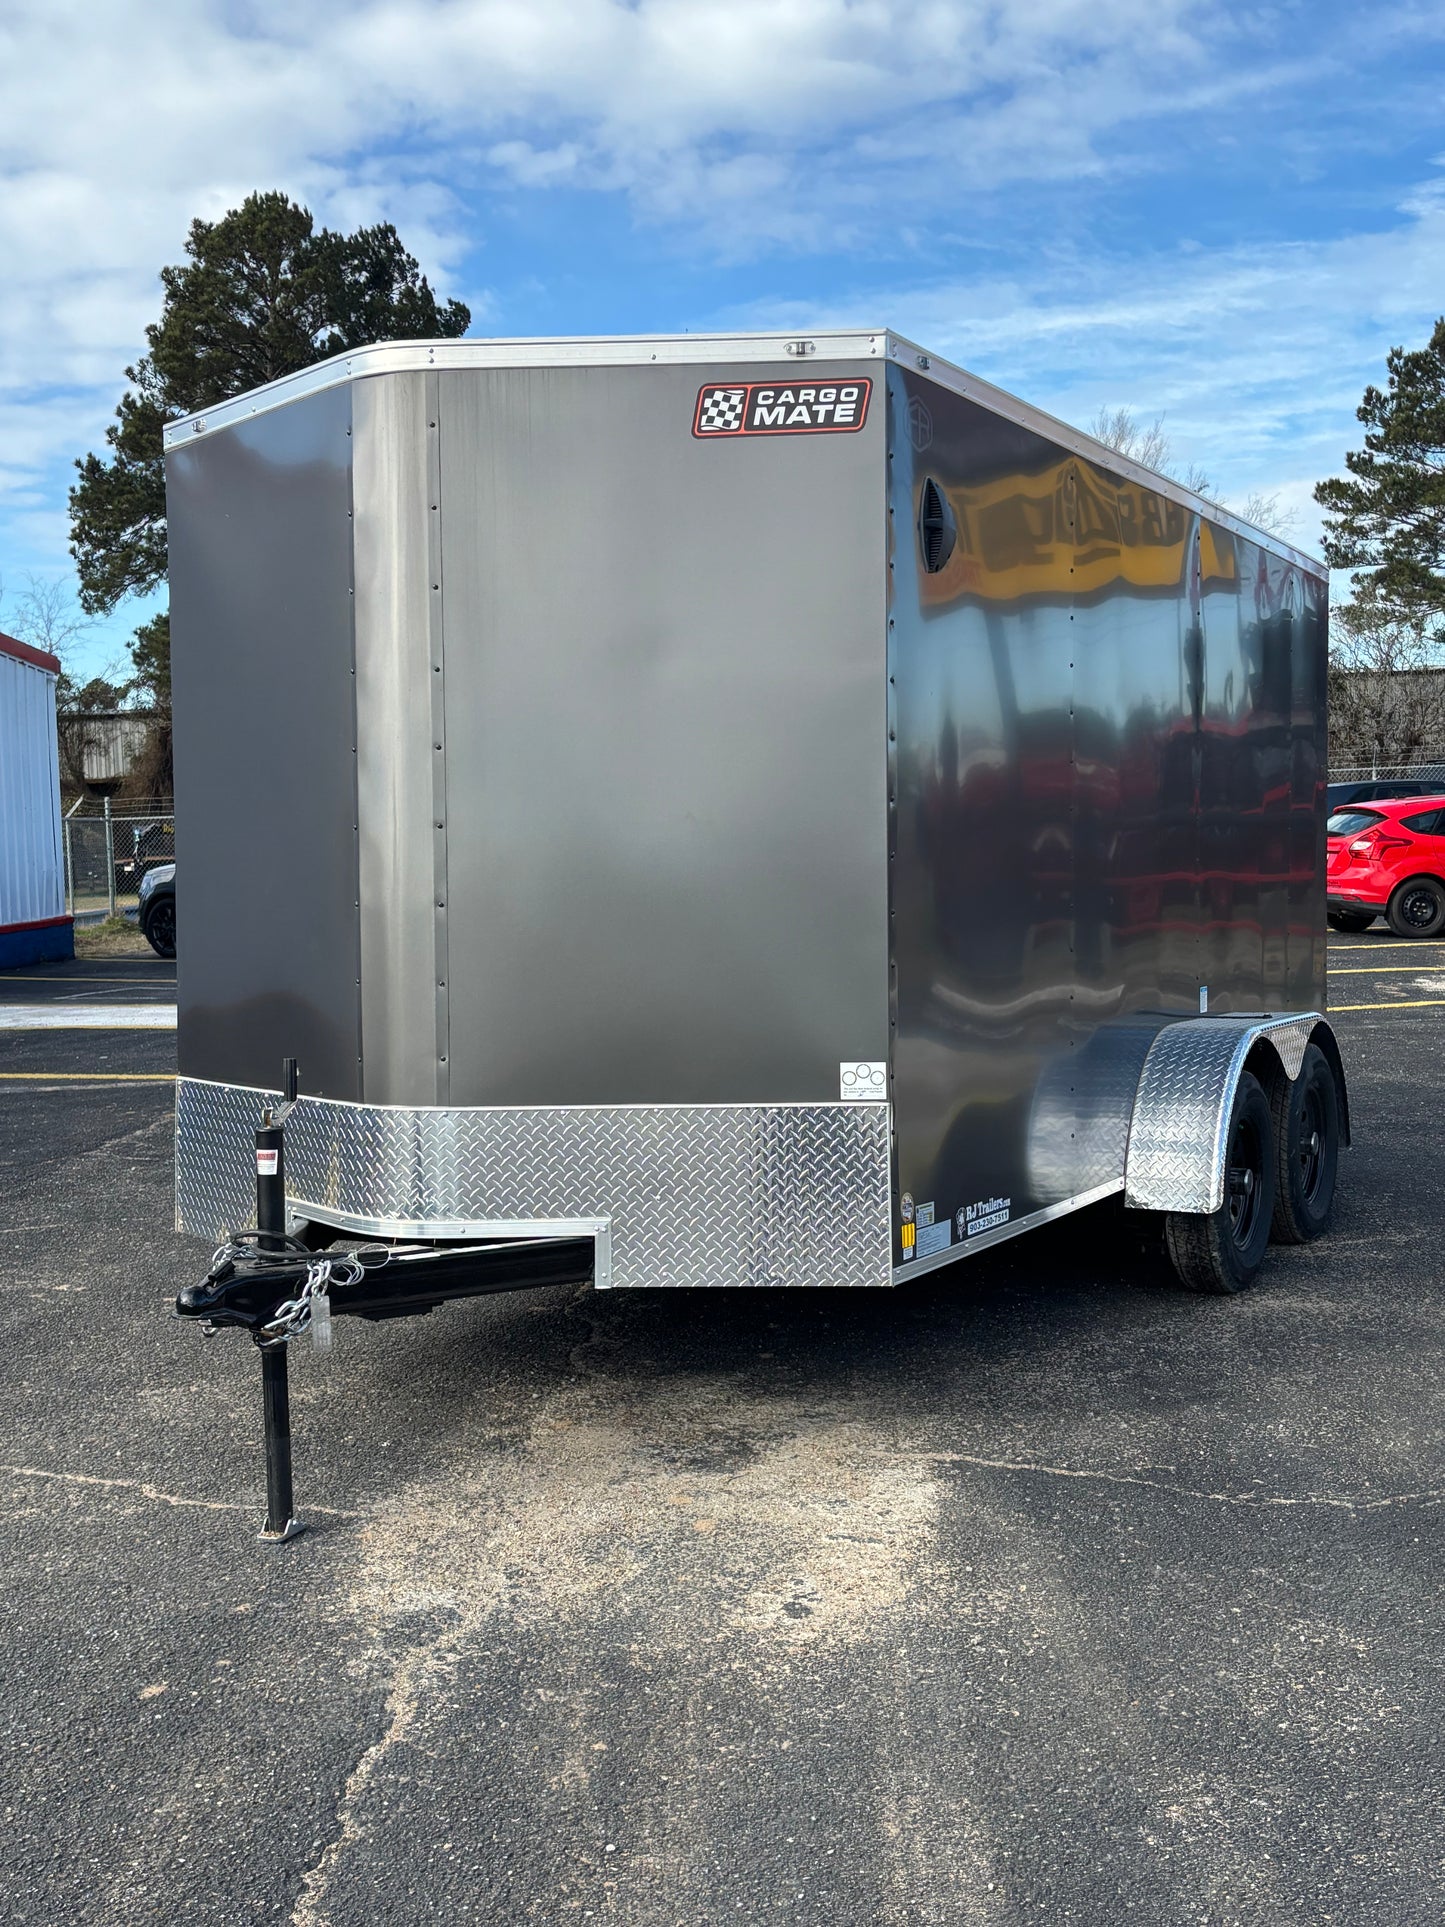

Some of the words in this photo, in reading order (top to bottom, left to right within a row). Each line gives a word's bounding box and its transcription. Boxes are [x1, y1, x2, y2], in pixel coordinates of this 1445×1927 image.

[757, 388, 859, 405] CARGO
[753, 404, 856, 426] MATE
[966, 1204, 977, 1221] RJ
